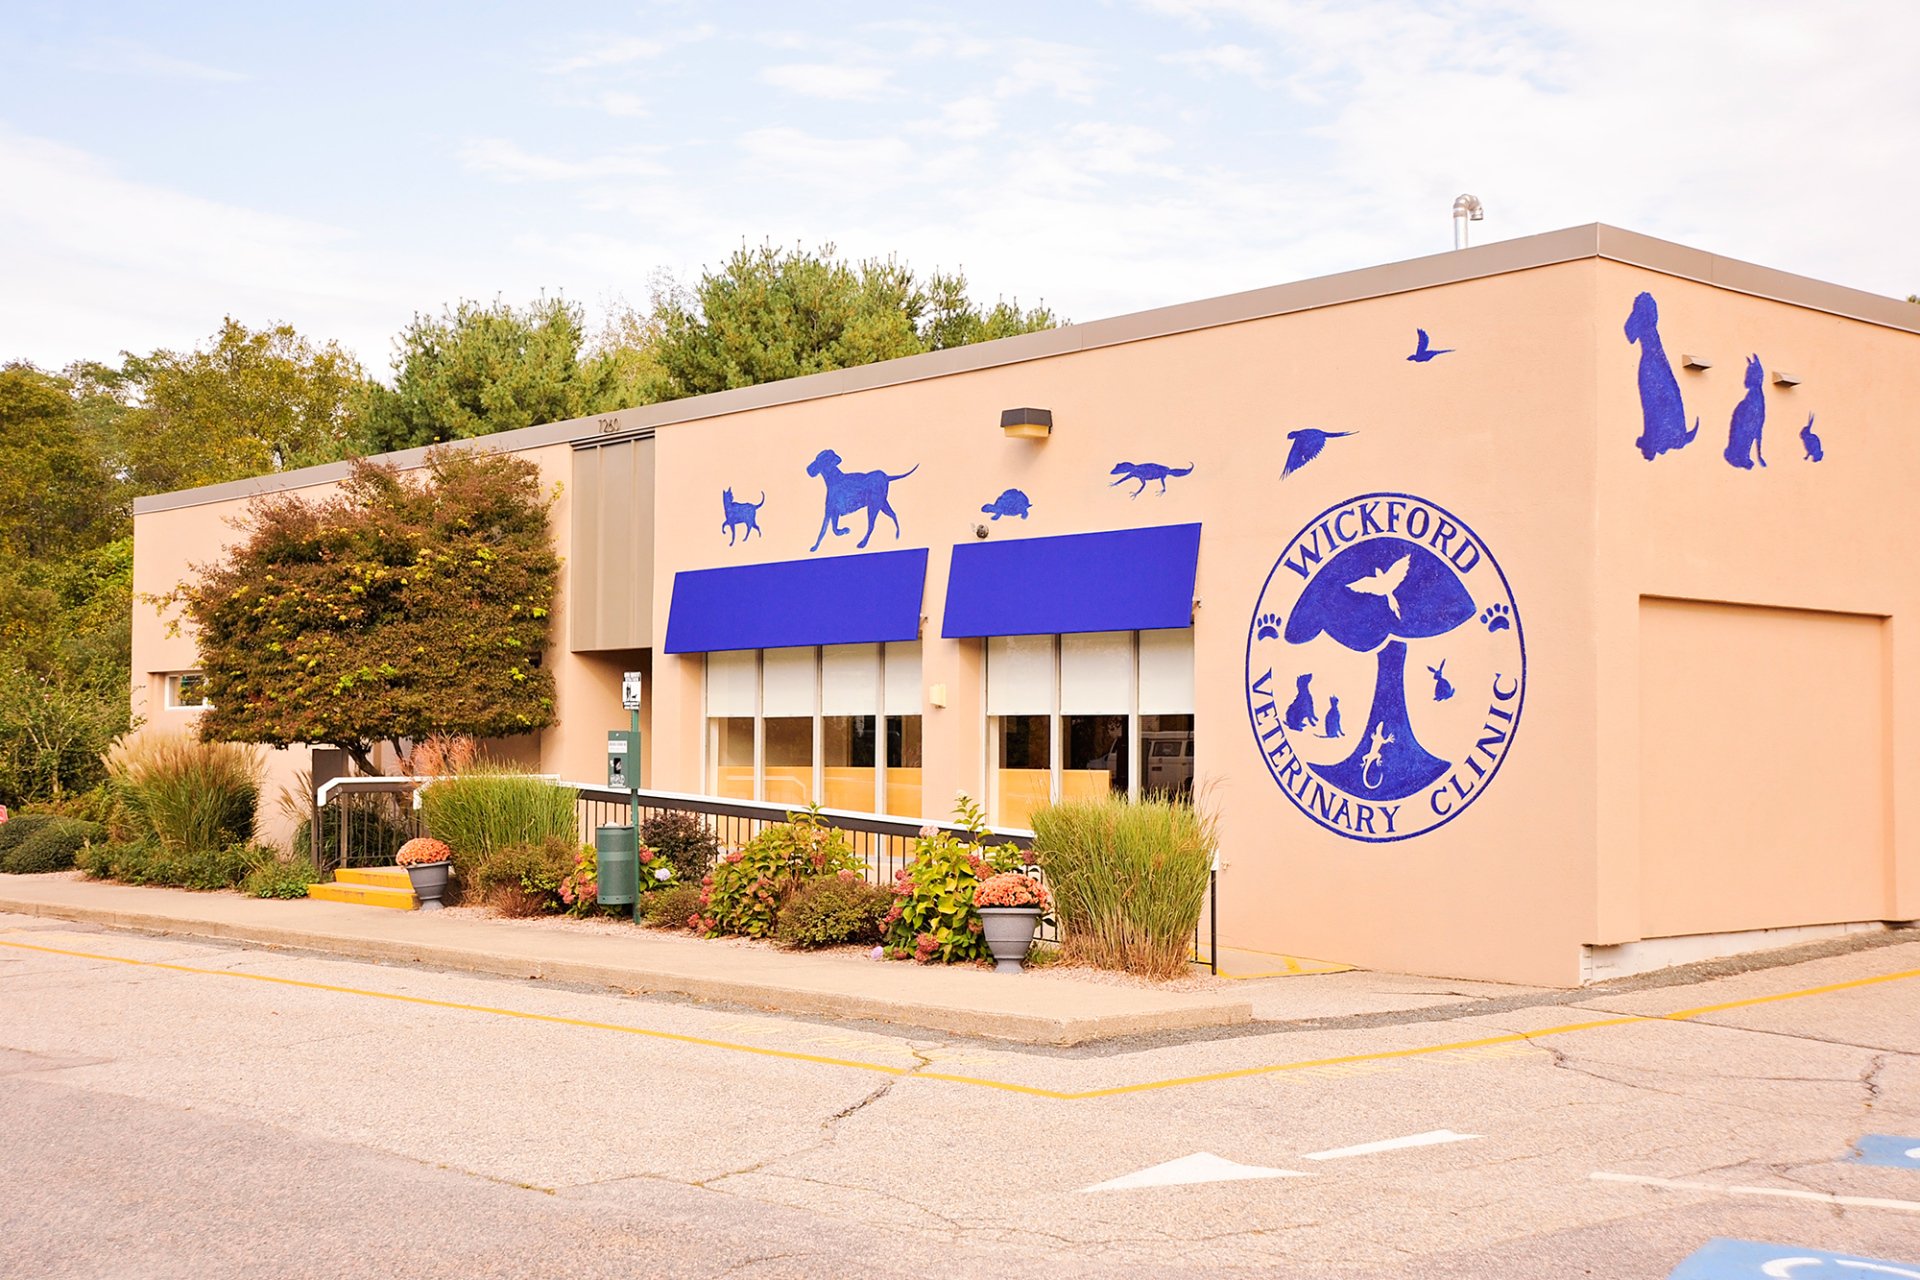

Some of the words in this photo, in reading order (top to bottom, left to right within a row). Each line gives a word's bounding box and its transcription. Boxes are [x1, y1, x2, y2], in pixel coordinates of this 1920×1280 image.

[1284, 500, 1481, 580] WICKFORD
[1252, 667, 1401, 834] VETERINARY
[1430, 672, 1518, 816] CLINIC
